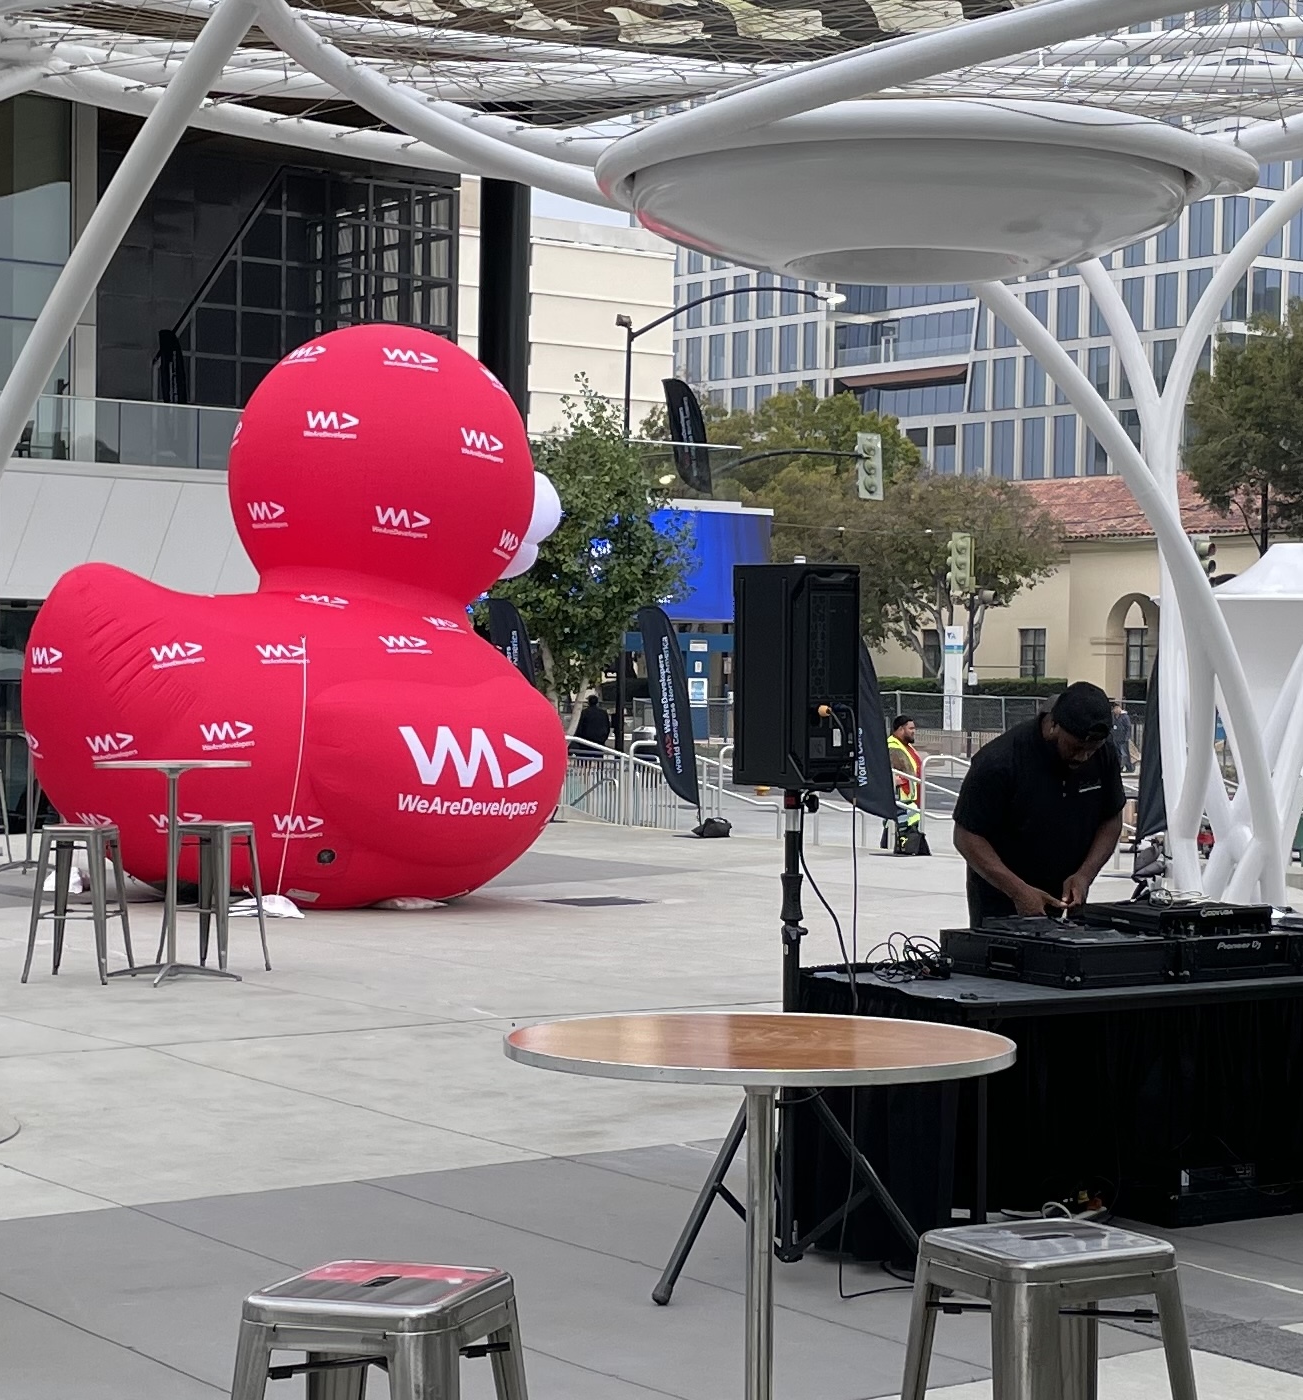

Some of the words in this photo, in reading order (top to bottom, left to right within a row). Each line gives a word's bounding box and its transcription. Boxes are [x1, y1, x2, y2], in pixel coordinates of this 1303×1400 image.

[661, 635, 672, 674] America
[658, 653, 672, 734] WeAreDevelopers
[667, 675, 675, 703] North
[670, 702, 680, 744] Congress
[673, 746, 683, 774] World
[398, 793, 539, 820] WeAreDevelopers
